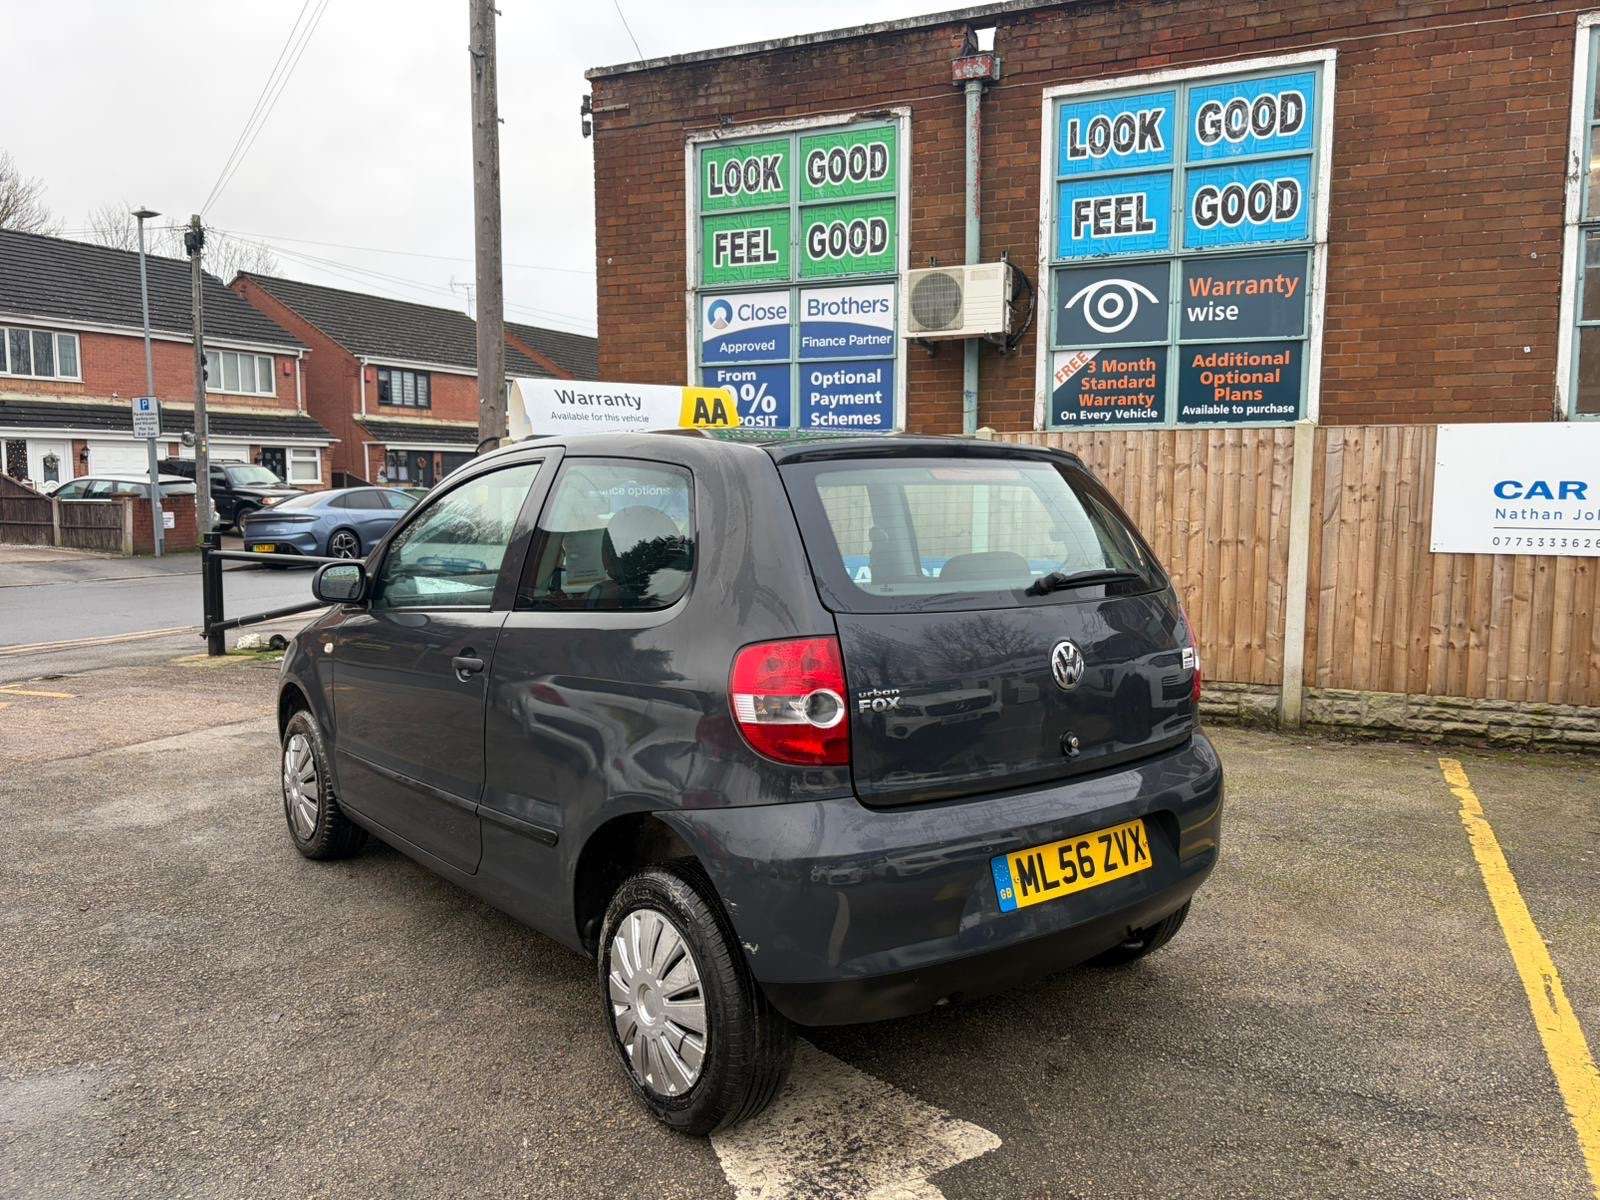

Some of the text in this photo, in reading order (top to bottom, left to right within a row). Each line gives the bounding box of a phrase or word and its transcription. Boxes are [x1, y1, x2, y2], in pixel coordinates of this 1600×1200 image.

[1067, 91, 1305, 160] LOOK GOOD
[709, 142, 888, 197] LOOK GOOD
[1072, 178, 1300, 239] FEEL GOOD
[714, 217, 888, 267] FEEL GOOD
[1189, 274, 1299, 298] Warranty
[738, 296, 889, 321] Close Brothers
[1188, 302, 1239, 322] wise
[720, 335, 892, 354] Approved Finance Partner
[1056, 352, 1088, 382] FREE
[1088, 357, 1156, 373] 3 Month
[1192, 351, 1290, 368] Additional
[718, 371, 756, 382] From
[810, 368, 881, 388] Optional
[1082, 375, 1155, 390] Standard
[1200, 369, 1280, 387] Optional
[554, 389, 640, 410] Warranty
[810, 392, 882, 408] Payment
[1079, 393, 1155, 408] Warranty
[1214, 388, 1264, 401] Plans
[551, 412, 589, 420] Available
[592, 413, 602, 421] for
[605, 413, 620, 421] this
[693, 398, 728, 424] AA
[1061, 409, 1158, 421] On Every Vehicle
[1182, 404, 1294, 416] Available to purchase
[811, 412, 881, 426] Schemes
[1493, 480, 1588, 500] CAR
[1496, 509, 1562, 520] Nathan
[859, 689, 899, 698] urban
[859, 697, 900, 713] FOX
[1015, 826, 1146, 896] ML56 ZVX
[1000, 888, 1012, 900] GB
